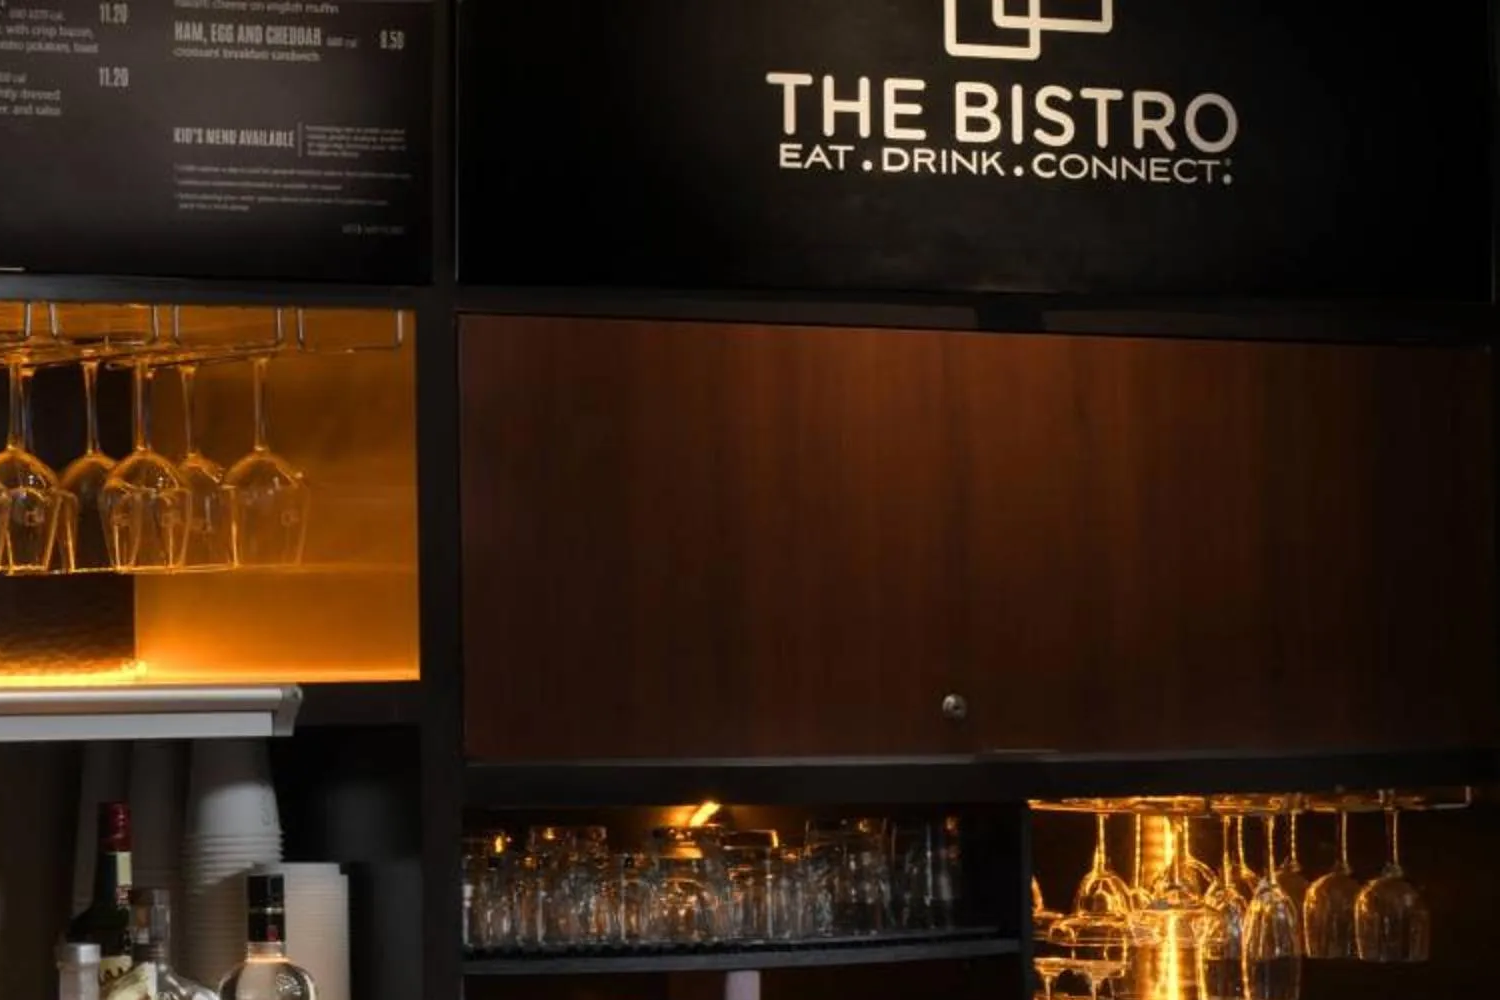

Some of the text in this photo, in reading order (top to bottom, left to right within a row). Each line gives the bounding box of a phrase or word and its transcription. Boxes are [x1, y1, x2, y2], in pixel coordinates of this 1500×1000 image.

[99, 3, 129, 24] 11.20
[174, 20, 207, 44] HAM,
[210, 22, 234, 43] EGG
[237, 24, 262, 45] AND
[265, 24, 321, 46] CHEDDAR
[99, 66, 130, 87] 11.20
[766, 72, 1238, 153] THE BISTRO
[239, 129, 295, 149] AVAILABLE
